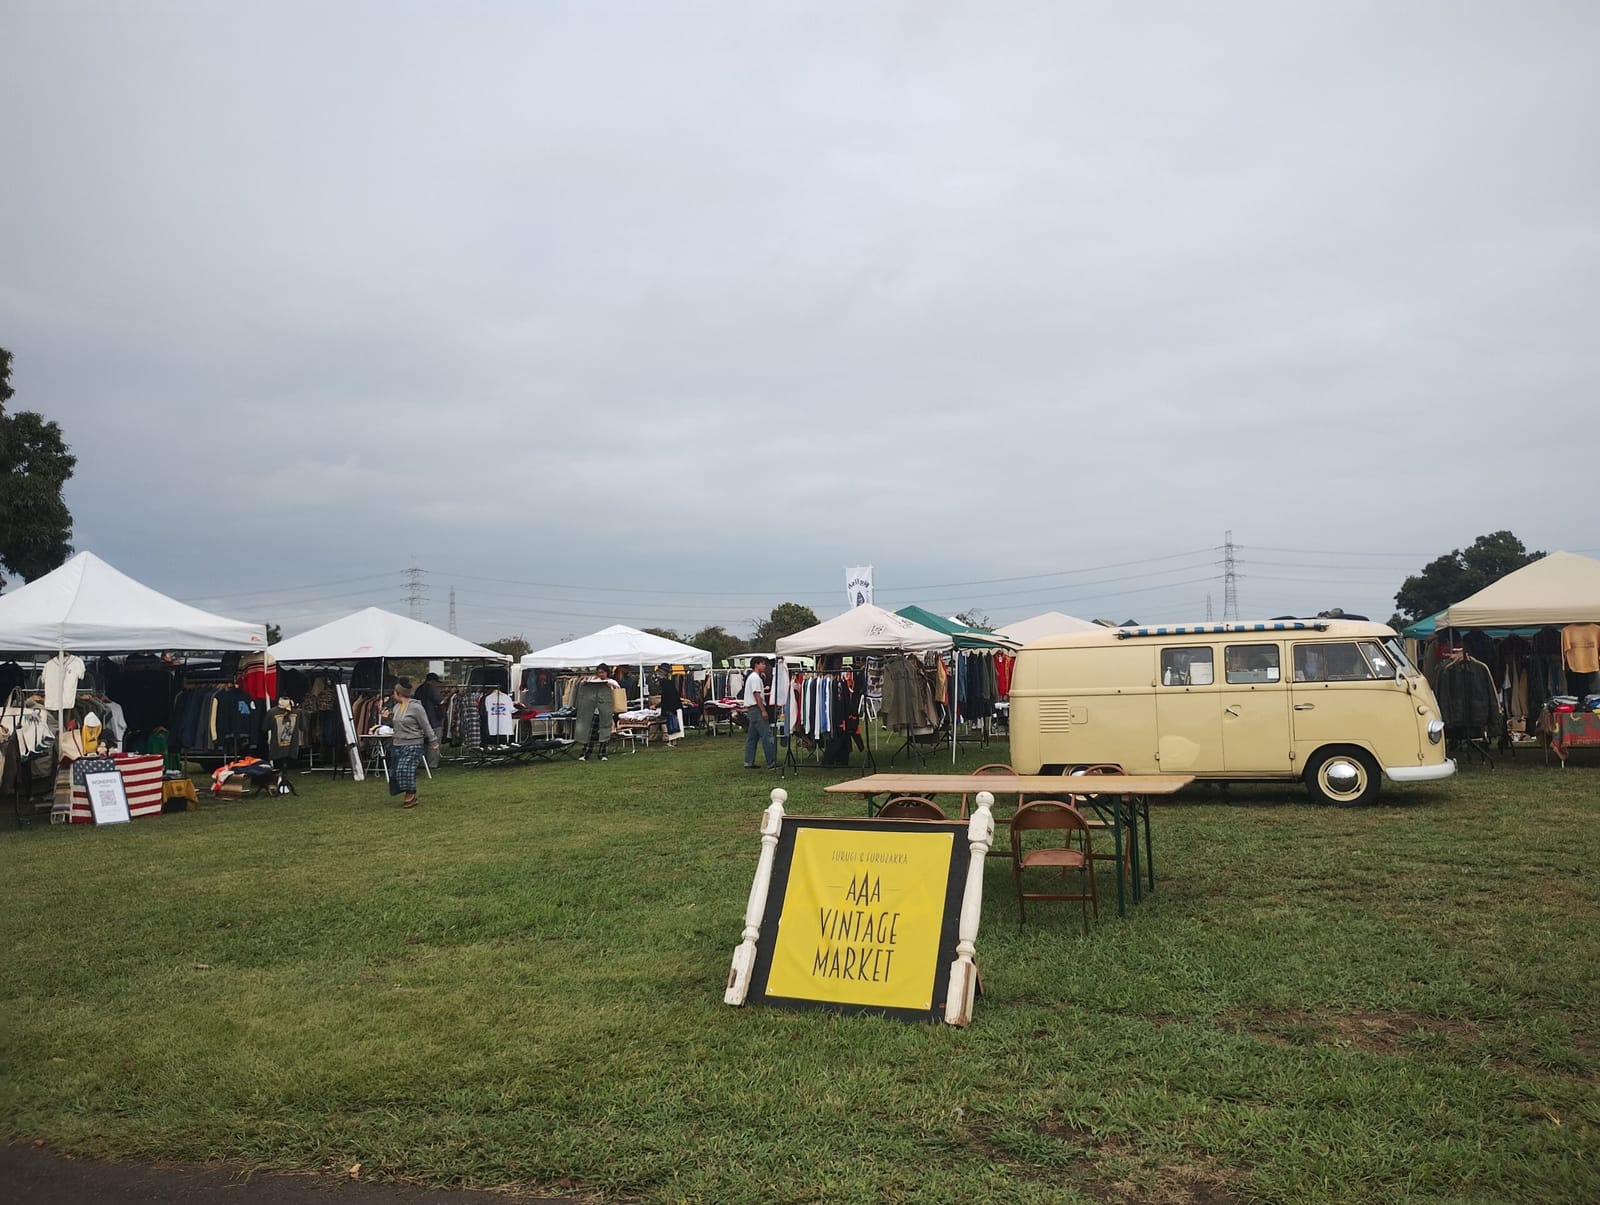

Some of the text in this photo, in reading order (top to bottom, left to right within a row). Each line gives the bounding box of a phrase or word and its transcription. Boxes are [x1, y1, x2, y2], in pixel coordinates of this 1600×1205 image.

[845, 870, 880, 907] AAA
[820, 906, 901, 945] VINTAGE
[812, 944, 895, 983] MARKET
